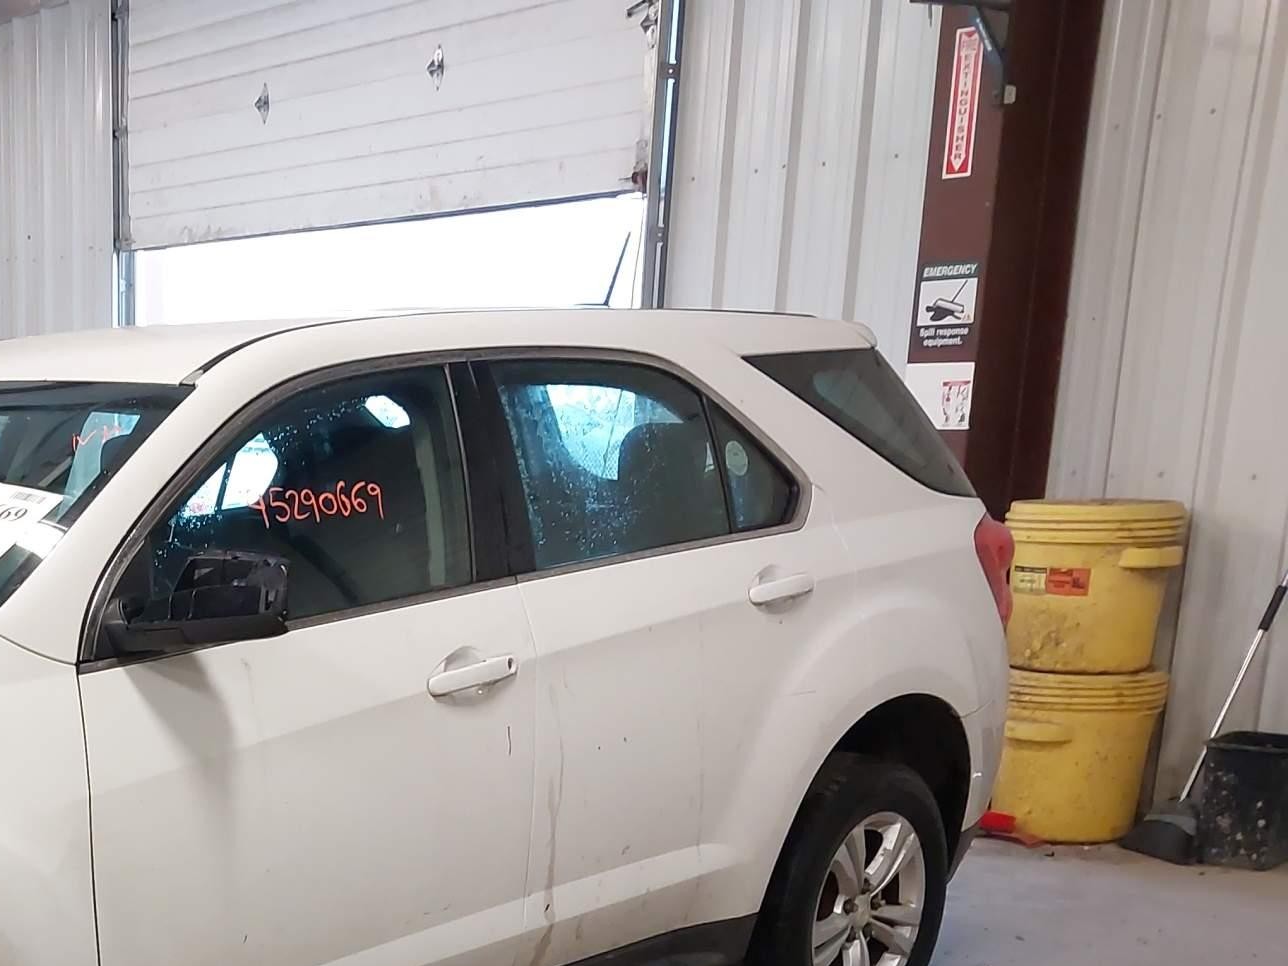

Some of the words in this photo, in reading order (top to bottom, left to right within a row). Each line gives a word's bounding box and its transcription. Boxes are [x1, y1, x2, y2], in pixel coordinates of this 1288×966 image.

[953, 54, 971, 160] EXTINGUISHER
[922, 263, 977, 278] EMERGENCY
[919, 328, 935, 338] Spill
[936, 327, 969, 337] response
[248, 480, 385, 529] 45290669
